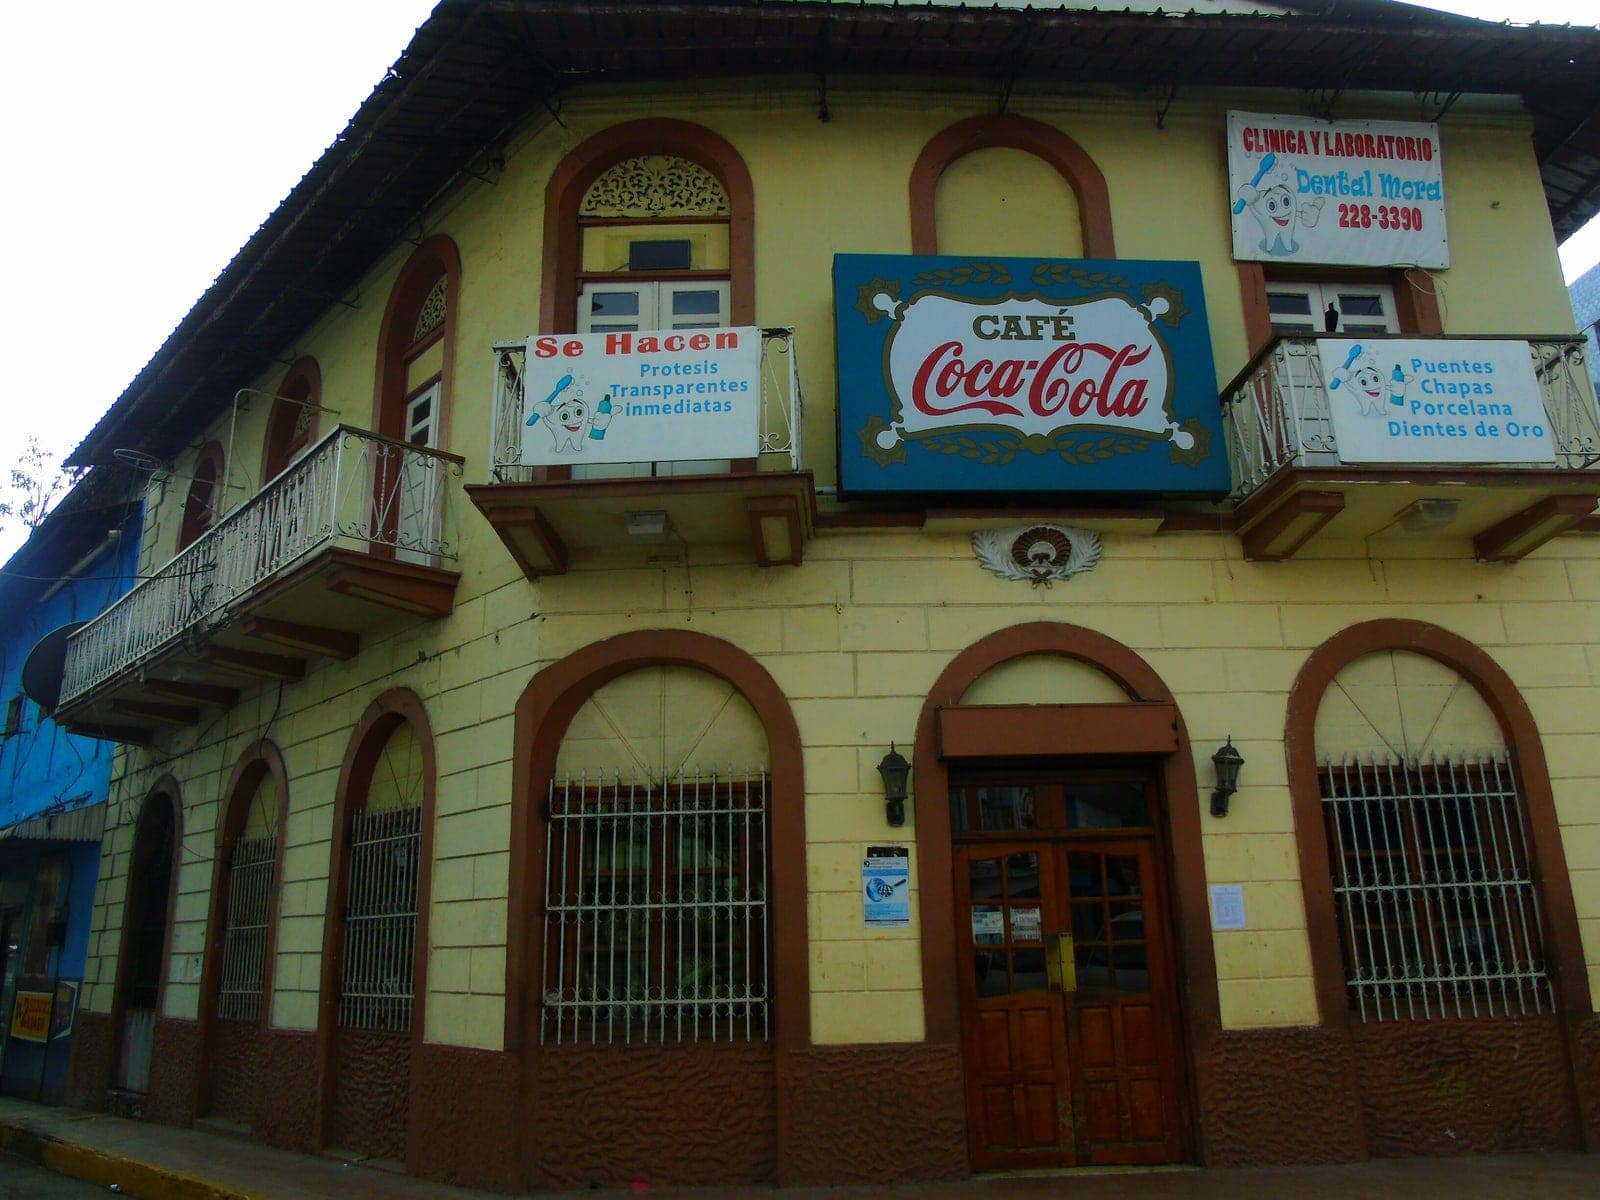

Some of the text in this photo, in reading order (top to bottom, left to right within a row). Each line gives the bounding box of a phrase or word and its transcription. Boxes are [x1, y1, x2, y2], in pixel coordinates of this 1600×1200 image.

[1243, 127, 1433, 161] CLINICA Y LABORATORIO
[1294, 167, 1373, 197] Dental
[1338, 203, 1422, 231] 228-3390
[972, 308, 1076, 341] CAFÉ
[535, 331, 739, 359] Se Hacen
[639, 359, 719, 378] Protesis
[1411, 358, 1493, 374] Puentes
[609, 378, 748, 398] Transparentes
[911, 341, 1152, 418] Coca-Cola
[1421, 379, 1493, 398] Chapas
[625, 400, 732, 417] inmediatas
[1410, 399, 1513, 416] Porcelana
[1388, 421, 1544, 438] Dientes de Oro
